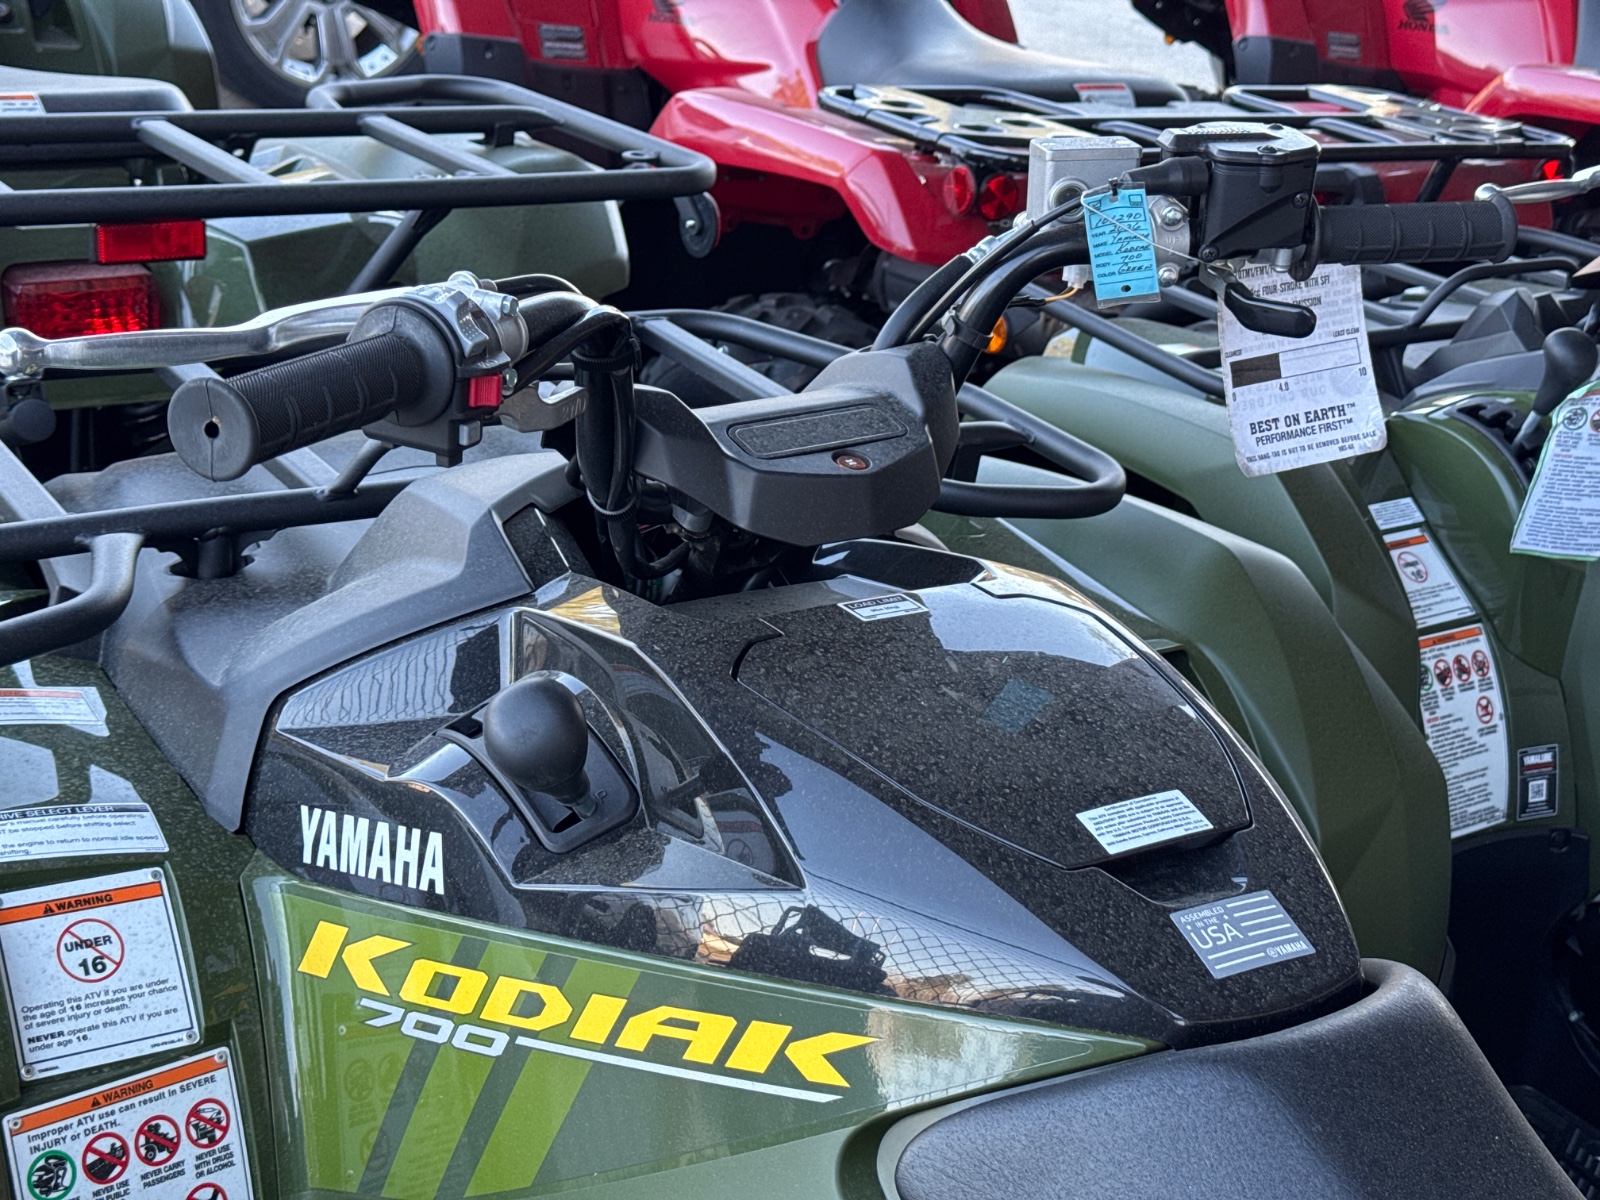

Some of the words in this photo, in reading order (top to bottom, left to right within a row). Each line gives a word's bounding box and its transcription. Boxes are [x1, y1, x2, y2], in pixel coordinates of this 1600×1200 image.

[1121, 253, 1142, 262] 700
[1304, 278, 1319, 287] WITH
[1358, 367, 1367, 376] 10
[1279, 382, 1289, 392] 4.0
[1232, 392, 1237, 402] 0
[1249, 418, 1280, 435] BEST
[1284, 413, 1300, 428] ON
[1256, 426, 1317, 447] PERFORMANCE
[1316, 439, 1339, 449] REMOVED
[1341, 434, 1361, 444] BEFORE
[1362, 430, 1377, 440] SALE
[848, 601, 876, 609] LOAD
[877, 596, 902, 604] LIMIT
[26, 808, 73, 817] SELECT
[21, 825, 54, 833] stopped
[300, 804, 445, 895] YAMAHA
[55, 894, 113, 911] WARNING
[1180, 906, 1224, 923] ASSEMBLED
[1204, 917, 1219, 926] THE
[64, 935, 113, 952] UNDER
[1190, 922, 1244, 949] USA
[1276, 940, 1308, 955] YAMAHA
[78, 955, 107, 976] 16
[21, 999, 64, 1013] Operating
[67, 996, 82, 1005] this
[85, 991, 102, 1001] ATV
[104, 989, 109, 997] if
[112, 986, 127, 997] you
[129, 983, 143, 991] are
[145, 978, 169, 988] under
[23, 1013, 37, 1022] the
[40, 1008, 56, 1020] age
[70, 1004, 82, 1012] 16
[84, 995, 126, 1009] increases
[127, 991, 146, 1001] your
[148, 984, 178, 996] chance
[297, 919, 881, 1088] KODIAK
[25, 1022, 33, 1030] of
[36, 1017, 65, 1028] severe
[67, 1010, 91, 1022] injury
[93, 1008, 102, 1016] or
[104, 1002, 131, 1014] death.
[27, 1030, 65, 1044] NEVER
[68, 1023, 100, 1036] operate
[102, 1019, 118, 1029] this
[119, 1015, 138, 1025] ATV
[139, 1012, 145, 1020] if
[146, 1011, 162, 1021] you
[164, 1007, 178, 1015] are
[359, 995, 510, 1058] 700
[29, 1043, 54, 1053] under
[57, 1039, 73, 1047] age
[76, 1034, 92, 1043] 16.
[102, 1079, 154, 1103] WARNING
[27, 1123, 74, 1143] Improper
[76, 1114, 95, 1127] ATV
[99, 1109, 116, 1120] use
[118, 1103, 136, 1113] can
[138, 1093, 166, 1107] result
[168, 1088, 177, 1097] in
[179, 1074, 216, 1094] SEVERE
[29, 1135, 68, 1155] INJURY
[70, 1133, 80, 1142] or
[84, 1120, 121, 1137] DEATH.
[194, 1160, 211, 1171] WITH
[212, 1151, 234, 1164] DRUGS
[195, 1148, 217, 1160] NEVER
[218, 1143, 231, 1154] USE
[141, 1168, 163, 1181] NEVER
[163, 1159, 186, 1173] CARRY
[143, 1169, 186, 1189] PASSENGERS
[195, 1170, 205, 1179] OR
[206, 1160, 236, 1176] ALCOHOL
[92, 1184, 115, 1198] NEVER
[116, 1178, 130, 1188] USE
[106, 1188, 131, 1200] PUBLIC
